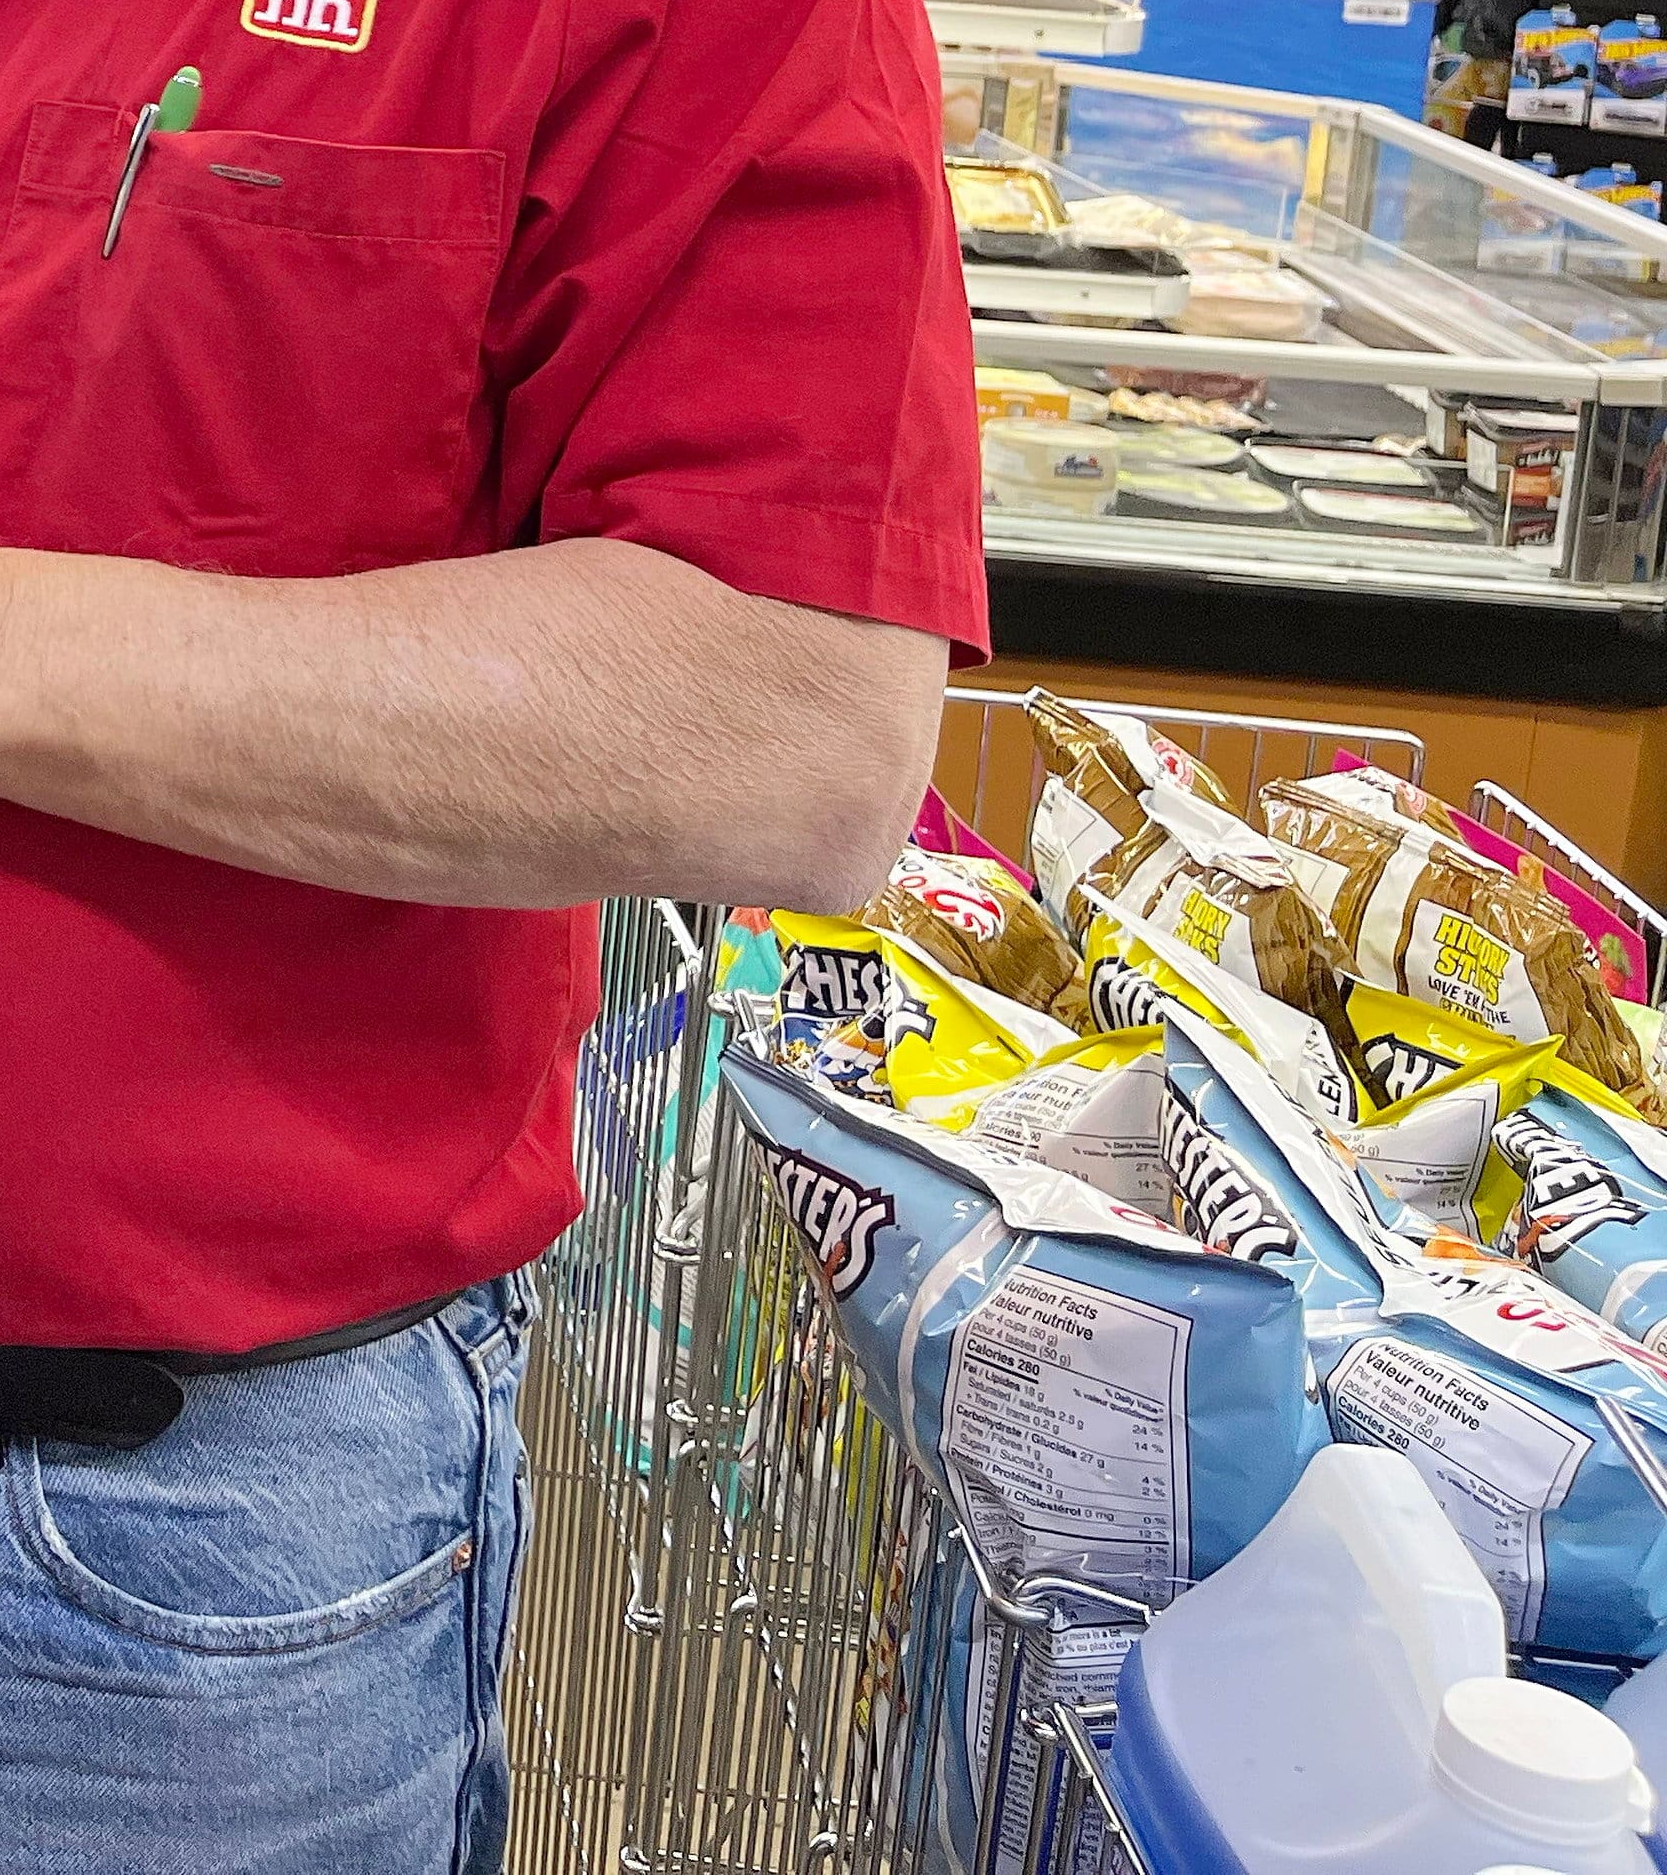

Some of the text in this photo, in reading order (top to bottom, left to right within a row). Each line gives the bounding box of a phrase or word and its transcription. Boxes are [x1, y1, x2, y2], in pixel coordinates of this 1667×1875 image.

[1427, 975, 1459, 1001] LOVE
[1138, 1179, 1151, 1190] 14
[1033, 1309, 1094, 1341] nutritive
[1059, 1296, 1099, 1321] Facts
[971, 1320, 995, 1338] pour
[1004, 1331, 1037, 1353] tasses
[1038, 1342, 1058, 1362] (50
[1059, 1352, 1072, 1367] g)
[978, 1307, 994, 1321] Per
[1004, 1316, 1028, 1336] cups
[1028, 1323, 1046, 1341] (50
[1046, 1333, 1059, 1347] g)
[966, 1338, 1041, 1377] Calories 280
[985, 1367, 1021, 1393] Lipides
[1365, 1349, 1481, 1432] Valeur nutritive
[1378, 1343, 1490, 1413] Nutrition Facts
[974, 1393, 999, 1412] Trans
[1005, 1404, 1031, 1424] trans
[1033, 1413, 1052, 1430] 0.2
[1353, 1365, 1440, 1427] Per cups (50 g)
[1058, 1408, 1075, 1426] 2.5
[1131, 1424, 1149, 1436] 24
[1338, 1395, 1410, 1450] Calories 280
[1343, 1380, 1446, 1449] pour tasses (50 g)
[955, 1404, 1022, 1437] Carbohydrate
[1031, 1433, 1078, 1460] Glucides
[1079, 1451, 1094, 1466] 27
[960, 1433, 991, 1457] Sugars
[999, 1449, 1036, 1471] Sucres
[991, 1432, 1023, 1453] Fibres
[1134, 1441, 1149, 1451] 14
[992, 1463, 1043, 1491] Protéines
[1013, 1489, 1082, 1516] Cholestérol
[1094, 1510, 1115, 1523] mg
